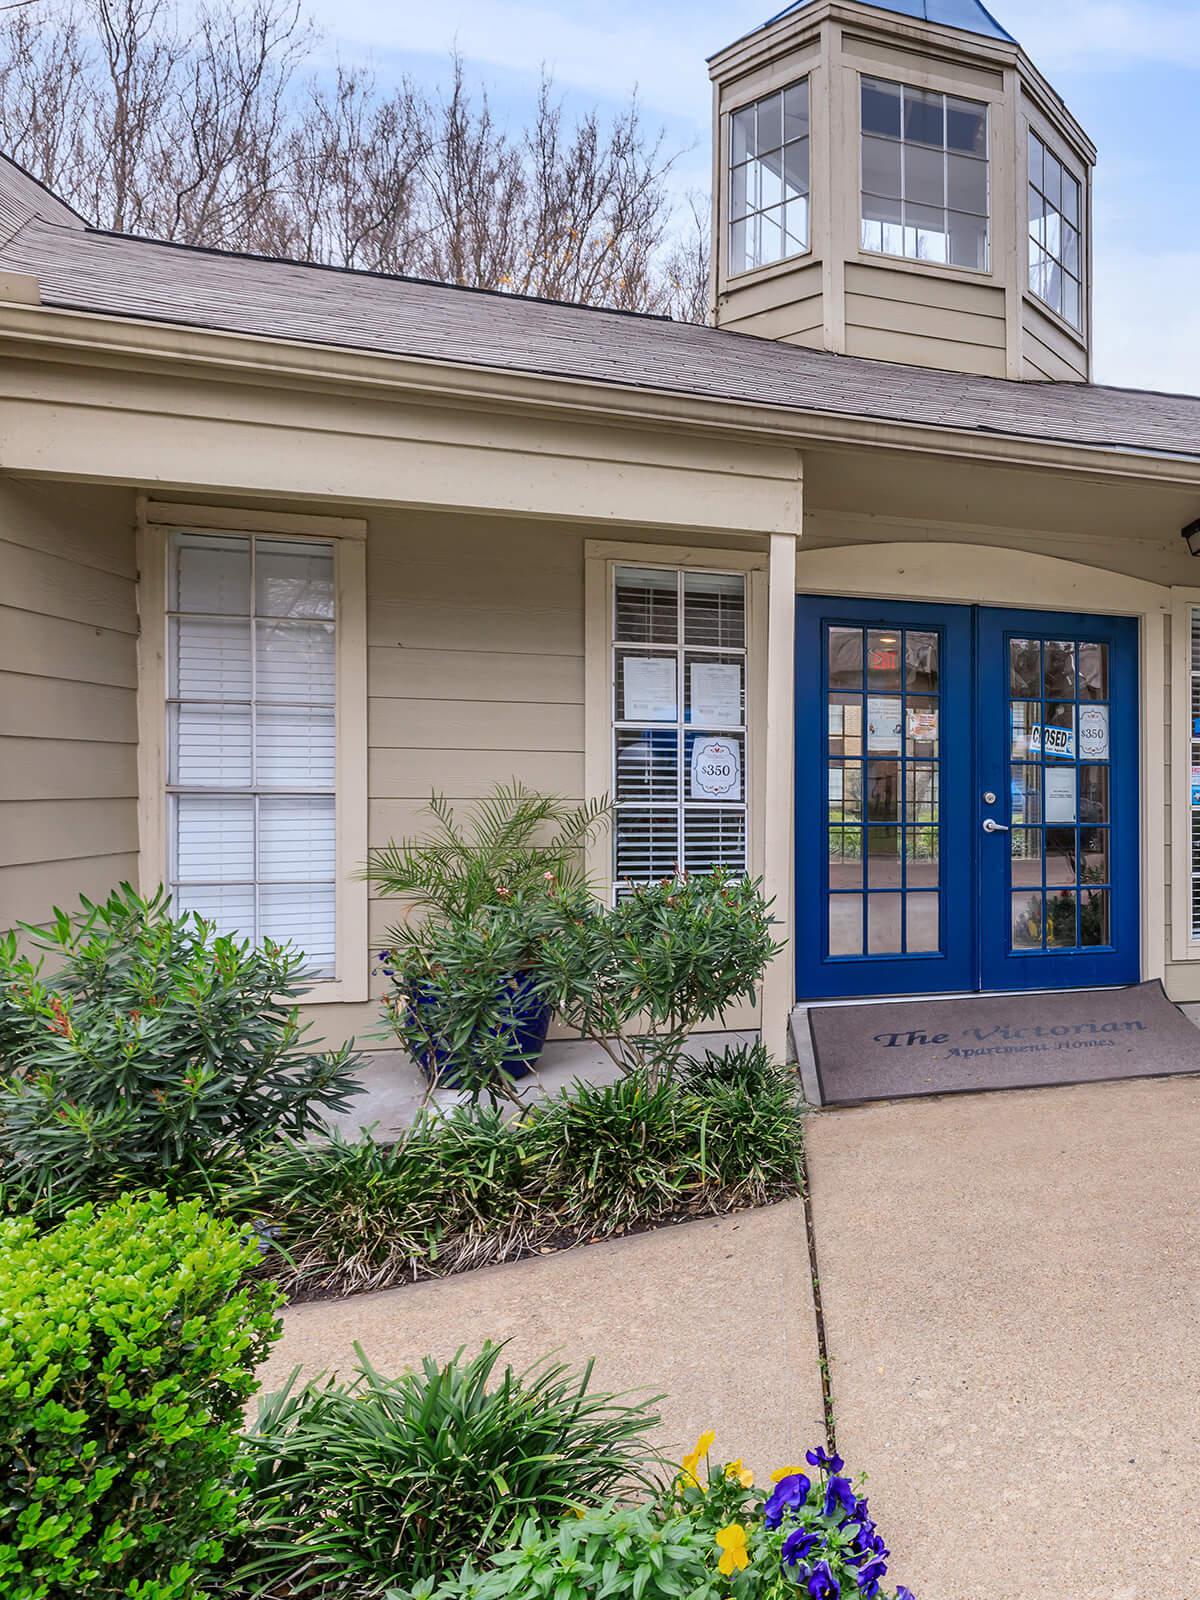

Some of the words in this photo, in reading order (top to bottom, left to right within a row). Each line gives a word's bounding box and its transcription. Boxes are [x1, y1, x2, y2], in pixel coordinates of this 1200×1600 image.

[1032, 727, 1067, 748] COSED
[1081, 728, 1104, 739] $350
[701, 764, 730, 776] $350
[873, 1029, 950, 1048] The
[962, 1019, 1148, 1041] Victorian
[944, 1044, 1049, 1059] Apartment
[1056, 1038, 1115, 1050] Homes
